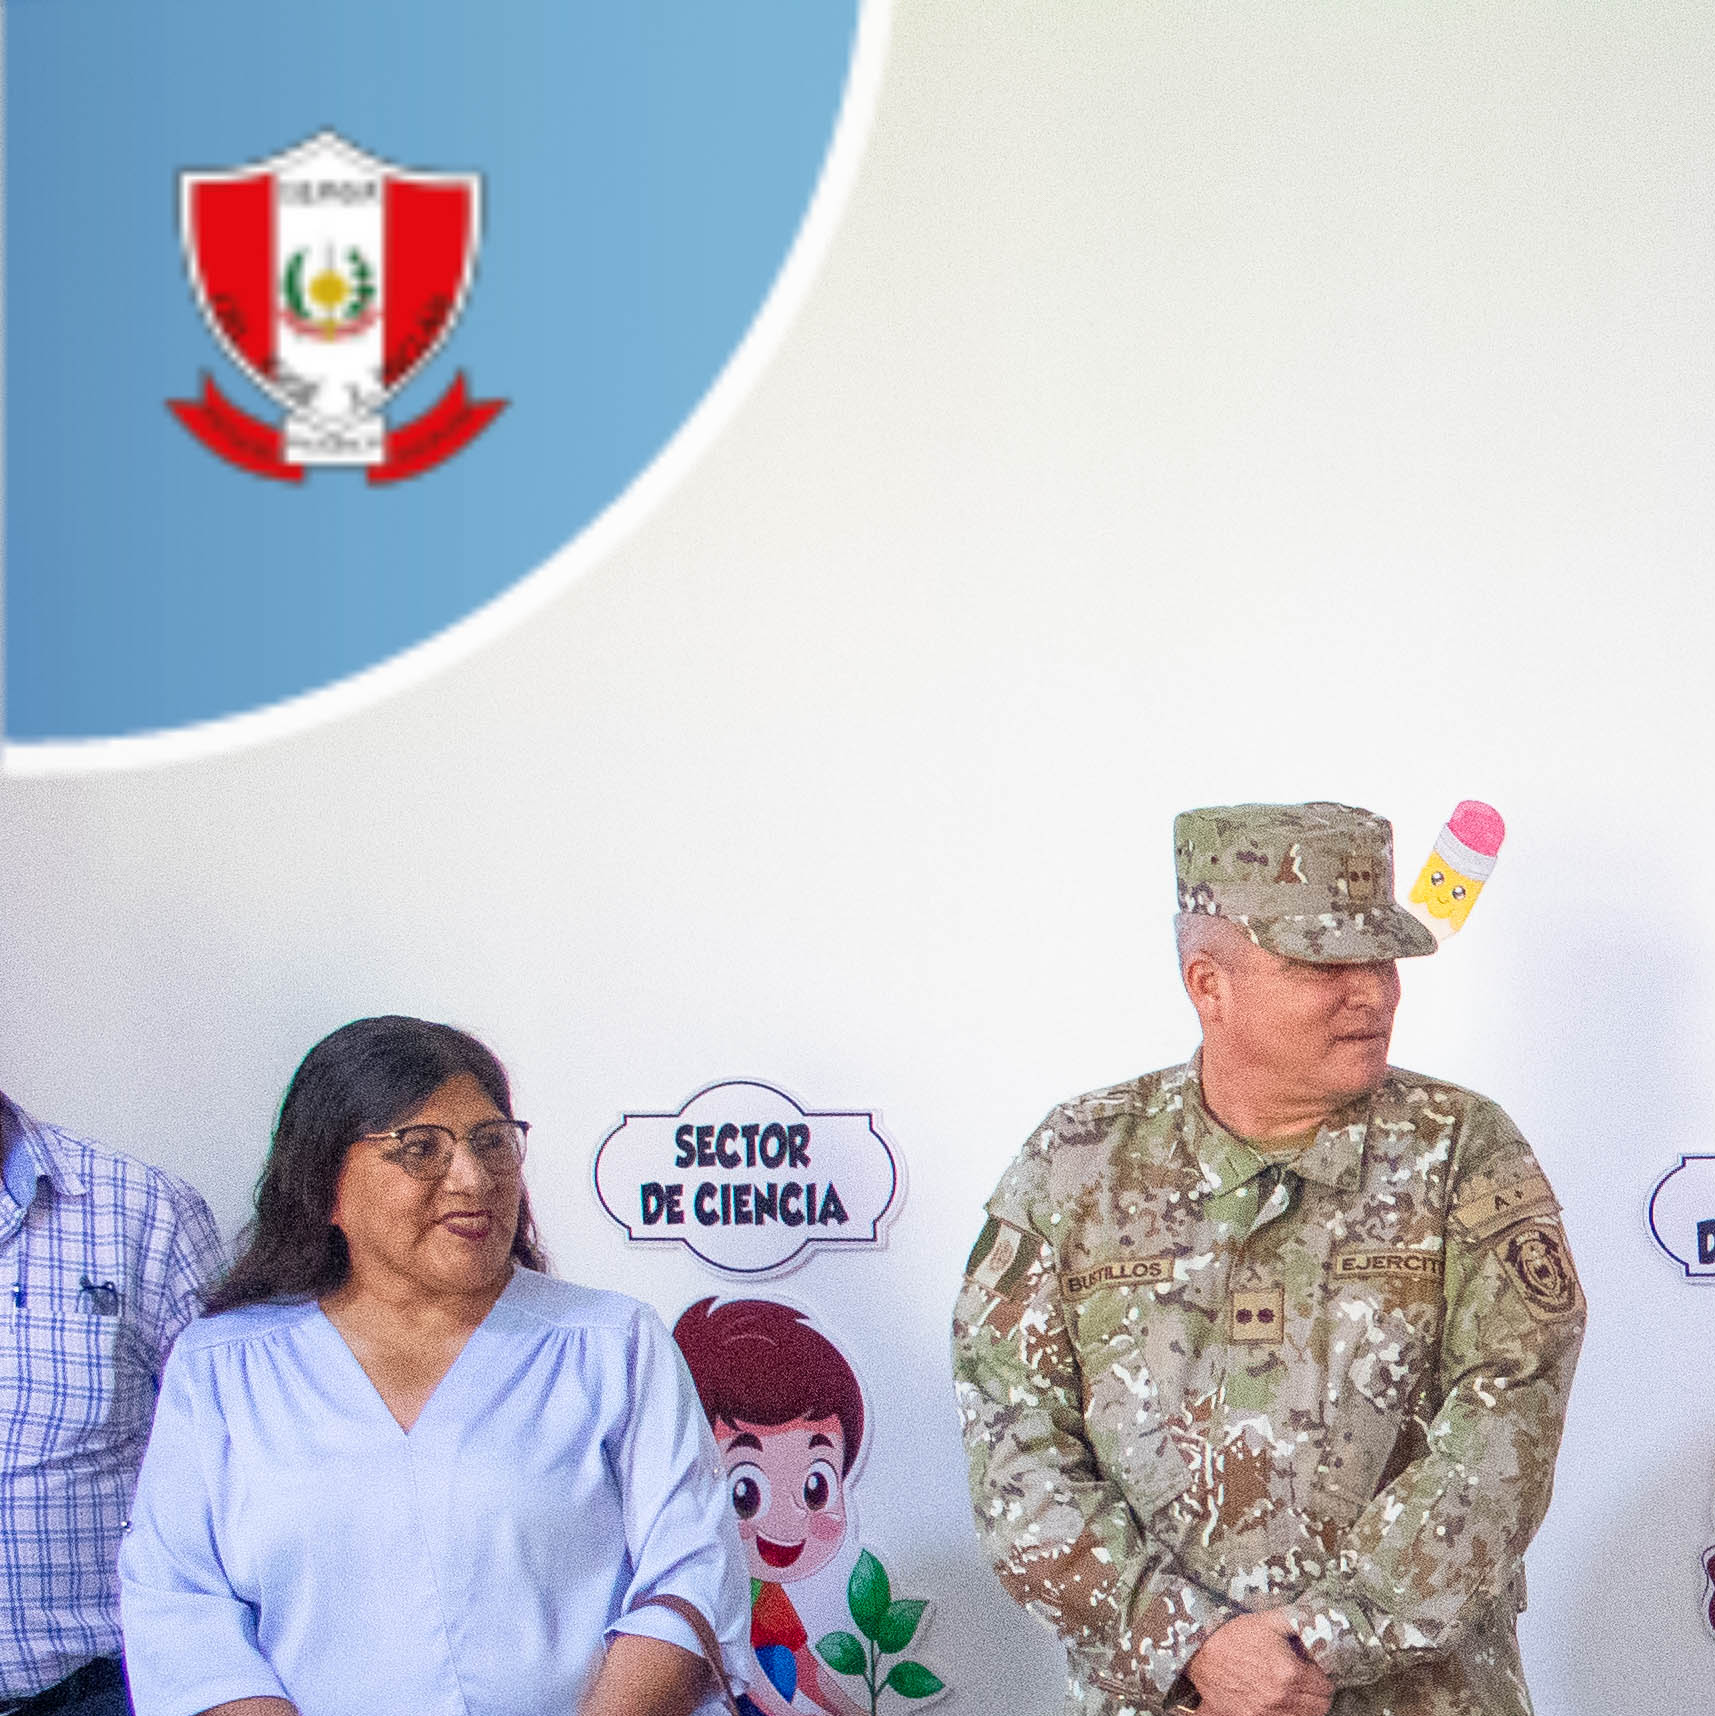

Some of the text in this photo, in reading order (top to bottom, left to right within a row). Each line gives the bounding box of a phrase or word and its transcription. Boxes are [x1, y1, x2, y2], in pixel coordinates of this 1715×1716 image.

[674, 1122, 811, 1169] SECTOR
[640, 1180, 850, 1227] DE CIENCIA
[1341, 1254, 1445, 1275] EJERCIT
